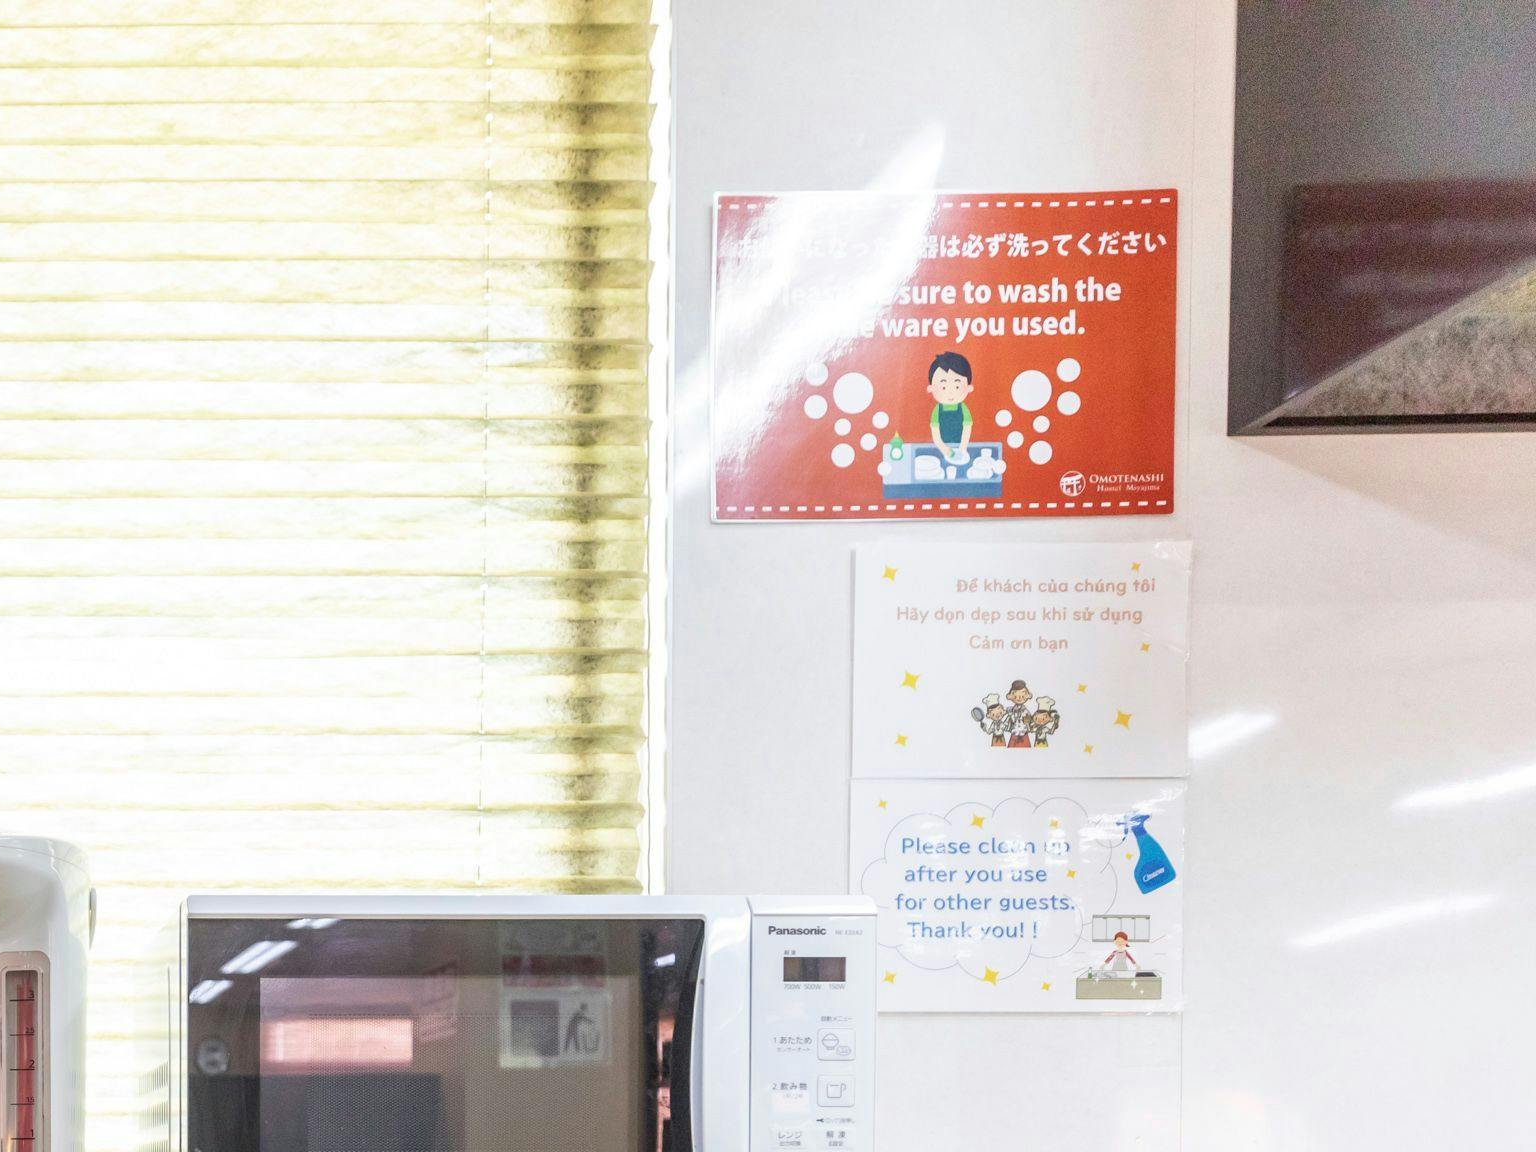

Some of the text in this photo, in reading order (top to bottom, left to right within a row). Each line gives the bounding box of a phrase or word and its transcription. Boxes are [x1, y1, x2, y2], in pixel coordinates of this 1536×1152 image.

[897, 276, 1122, 305] sure to wash the
[881, 316, 949, 338] ware
[954, 315, 1005, 344] you
[1012, 309, 1086, 336] used.
[1089, 473, 1164, 484] OMOTENASHI
[983, 578, 1032, 593] khách
[1074, 578, 1127, 597] chúng
[1006, 609, 1037, 621] sau
[1042, 606, 1067, 621] khi
[901, 837, 971, 855] Please
[978, 837, 1036, 855] clen
[904, 865, 1048, 884] after you use
[895, 893, 1076, 912] for other guests.
[768, 925, 827, 936] Panasonic
[906, 921, 972, 939] Thank
